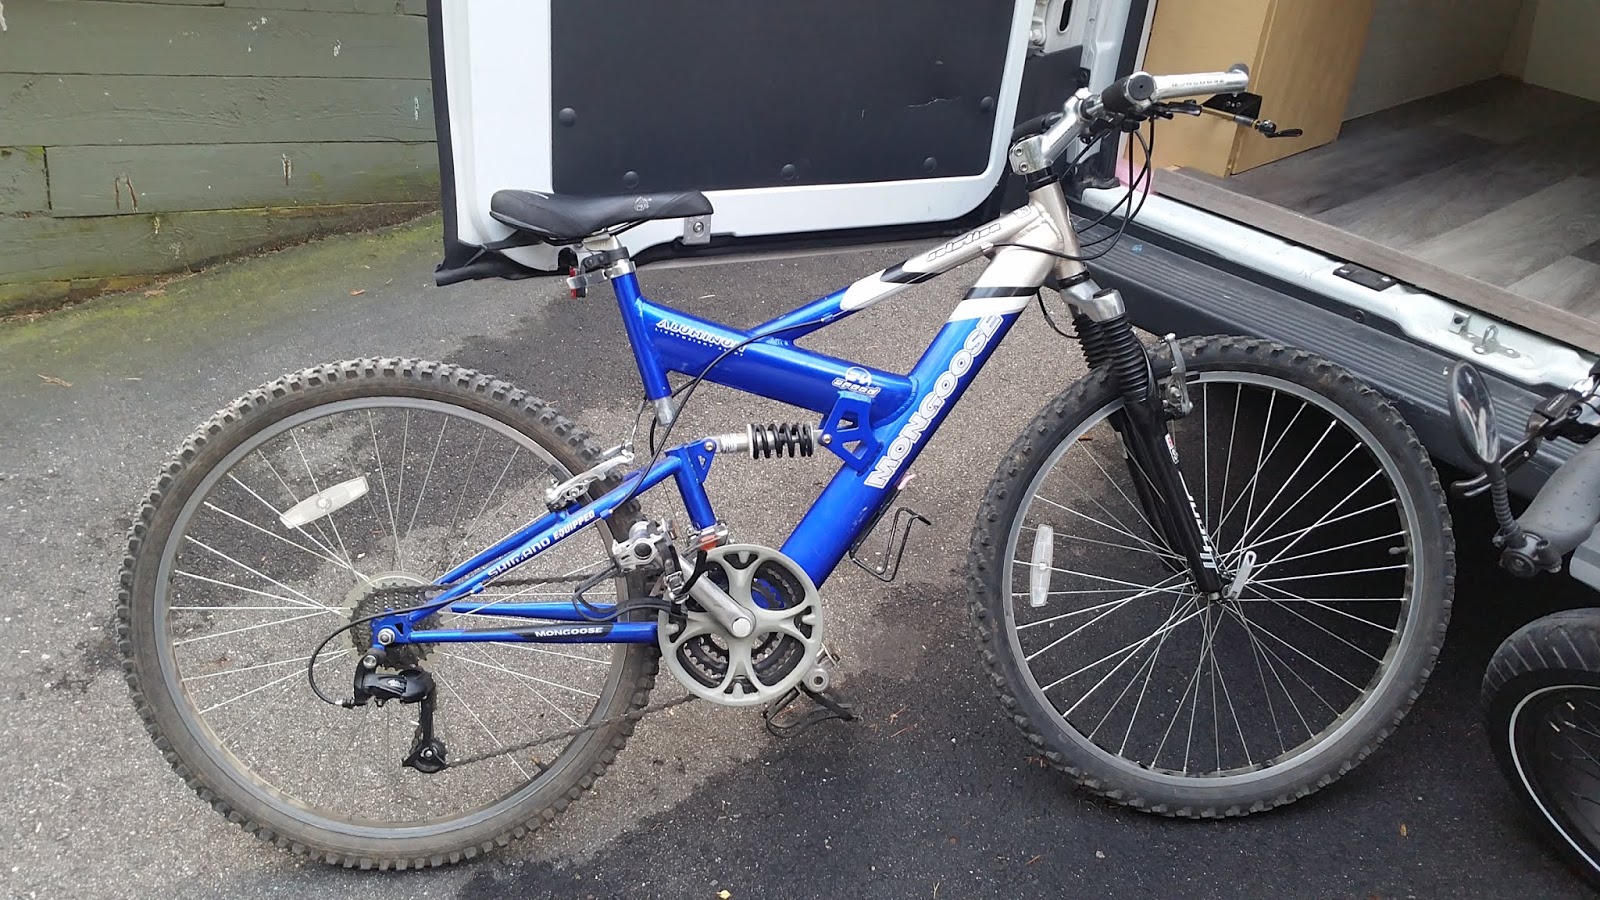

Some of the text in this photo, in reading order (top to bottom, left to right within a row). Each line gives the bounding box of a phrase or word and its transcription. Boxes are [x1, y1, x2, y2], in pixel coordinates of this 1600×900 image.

[655, 319, 748, 353] ALUMINUM
[717, 346, 744, 357] ALOY
[864, 315, 1004, 489] MONGOOSE
[487, 509, 596, 577] SHIMANO EQUIPPED
[534, 626, 604, 638] MONGOOSE
